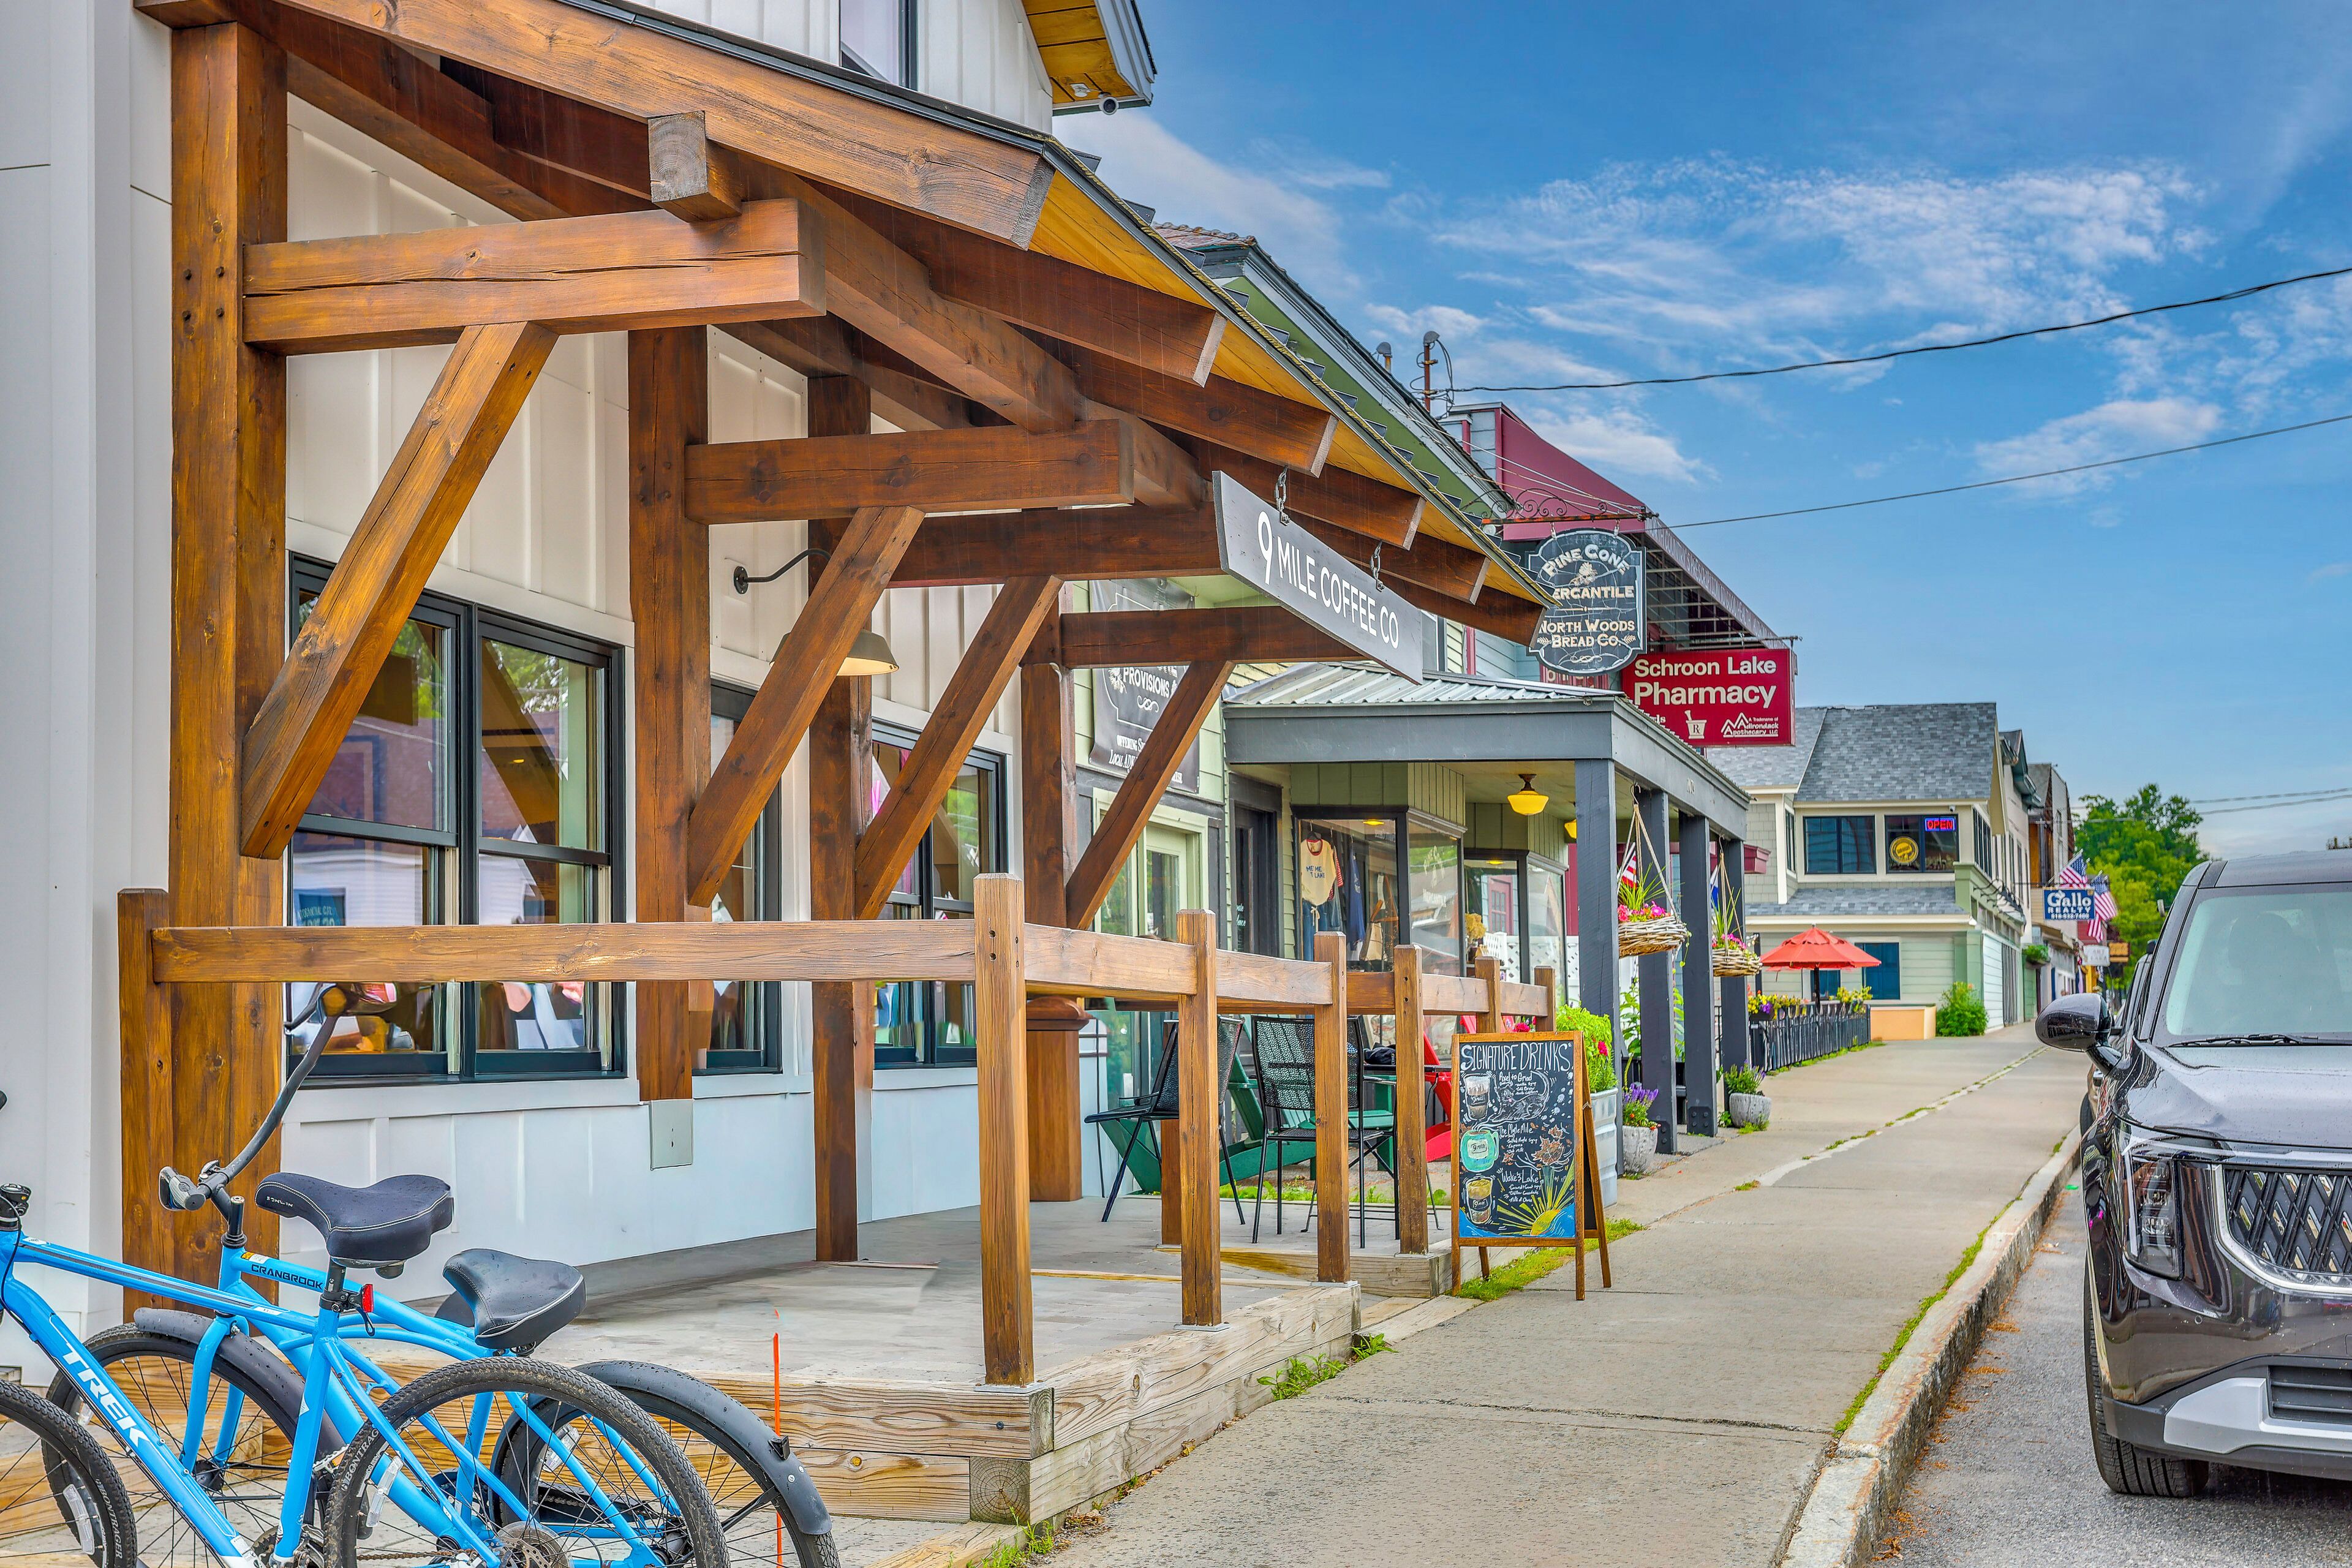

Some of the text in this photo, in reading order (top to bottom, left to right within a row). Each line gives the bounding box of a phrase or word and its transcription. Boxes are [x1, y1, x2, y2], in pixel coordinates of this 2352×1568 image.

[1542, 543, 1630, 577] PINE CONE
[1257, 511, 1399, 649] 9 MILE COFFEE CO
[1552, 585, 1635, 600] ERCANTILE
[1539, 619, 1635, 634] NORTH WOODS
[1551, 633, 1621, 648] BREAD CO.
[1634, 655, 1777, 677] Schroon Lake
[1123, 666, 1170, 698] PROVISIONS
[1634, 681, 1777, 709] Pharmacy
[1724, 725, 1766, 736] Apothecary
[1738, 719, 1779, 729] Adirondack
[1109, 749, 1123, 767] LOCAL
[1928, 820, 1953, 829] OPEN
[2047, 890, 2092, 907] Gallo
[1460, 1041, 1570, 1072] SIGNATURE DRINKS
[1499, 1071, 1510, 1082] Axel
[1517, 1071, 1532, 1082] Grind
[1497, 1122, 1533, 1134] The Maple Mile
[1502, 1170, 1517, 1182] Wake
[1521, 1169, 1539, 1183] Lake
[251, 1264, 324, 1290] CRANBROOK
[62, 1342, 151, 1447] TREK
[345, 1428, 379, 1483] BONTRAG
[99, 1487, 123, 1559] BONTRAGER
